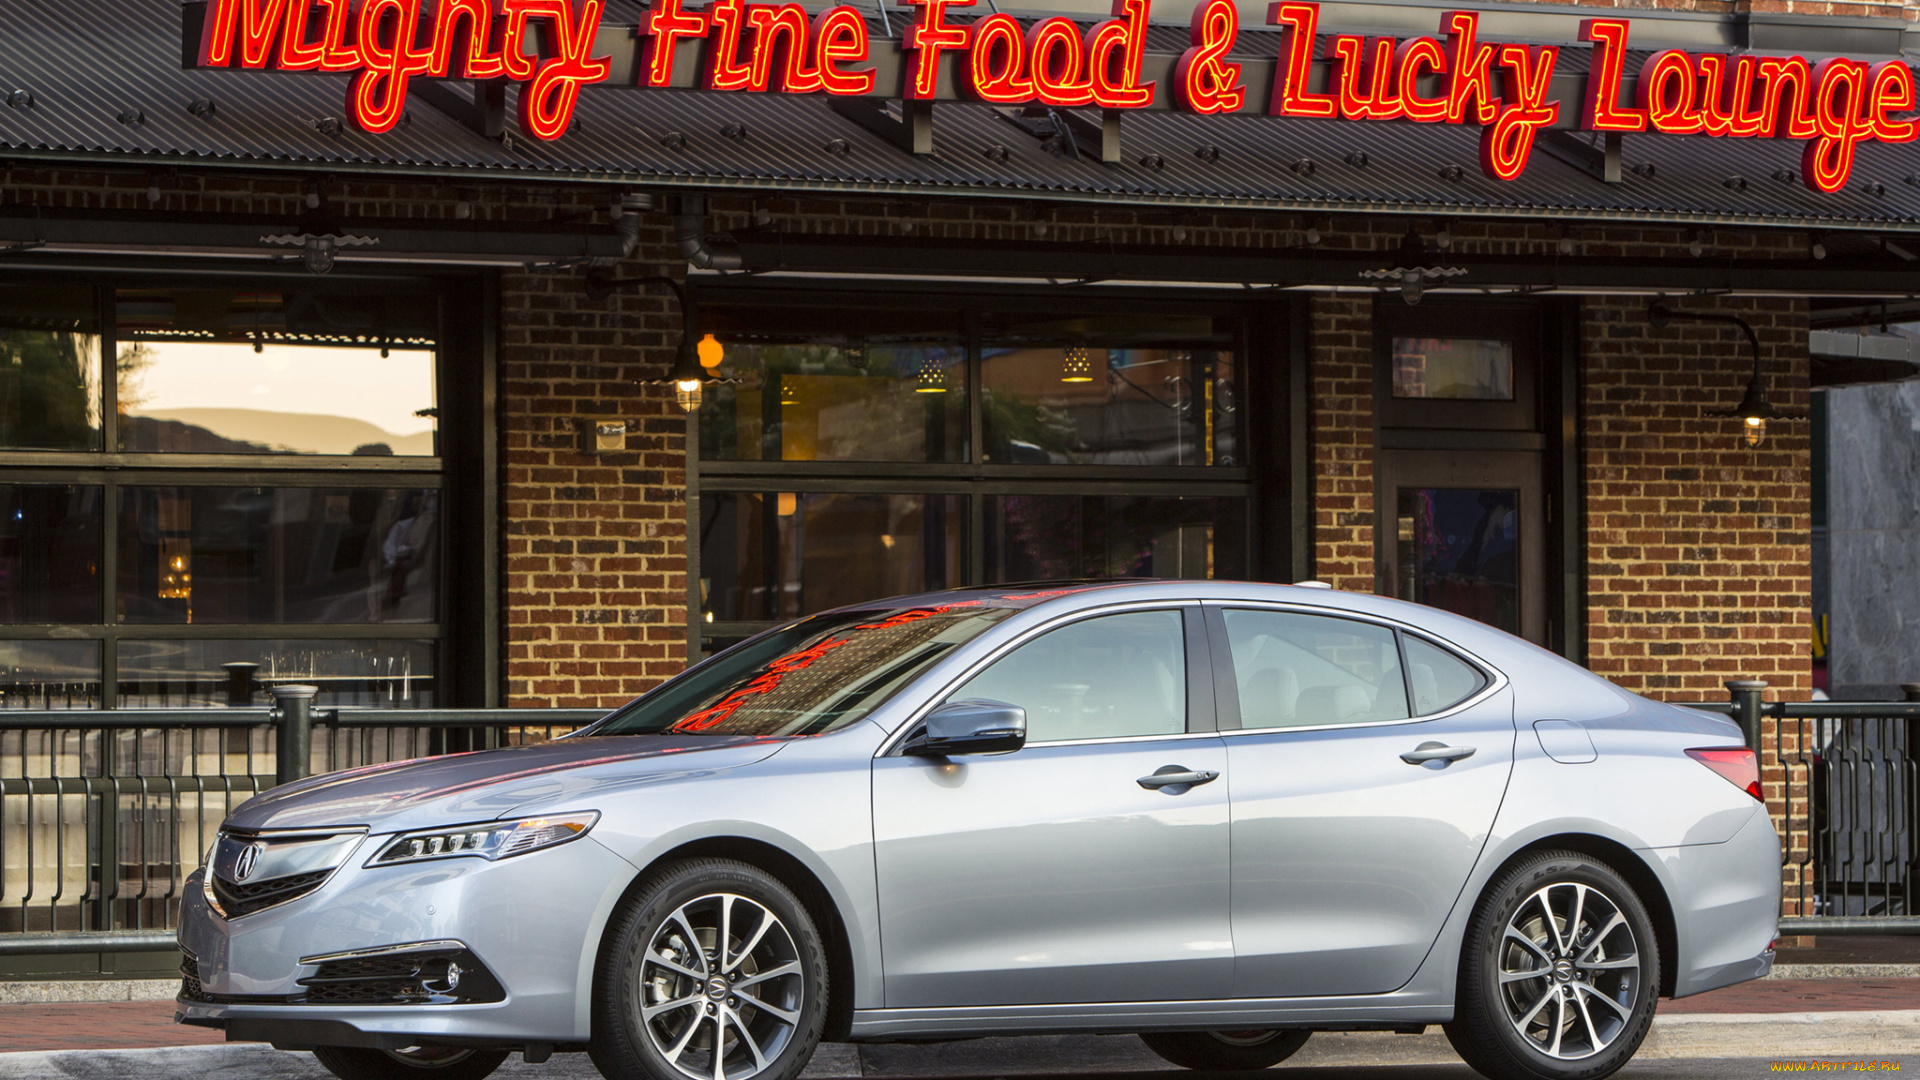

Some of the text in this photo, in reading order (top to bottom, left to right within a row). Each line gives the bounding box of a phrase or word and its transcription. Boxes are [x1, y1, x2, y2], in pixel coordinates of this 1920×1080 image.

[198, 0, 1920, 193] Mighty Fine Food & Lucky Lounge
